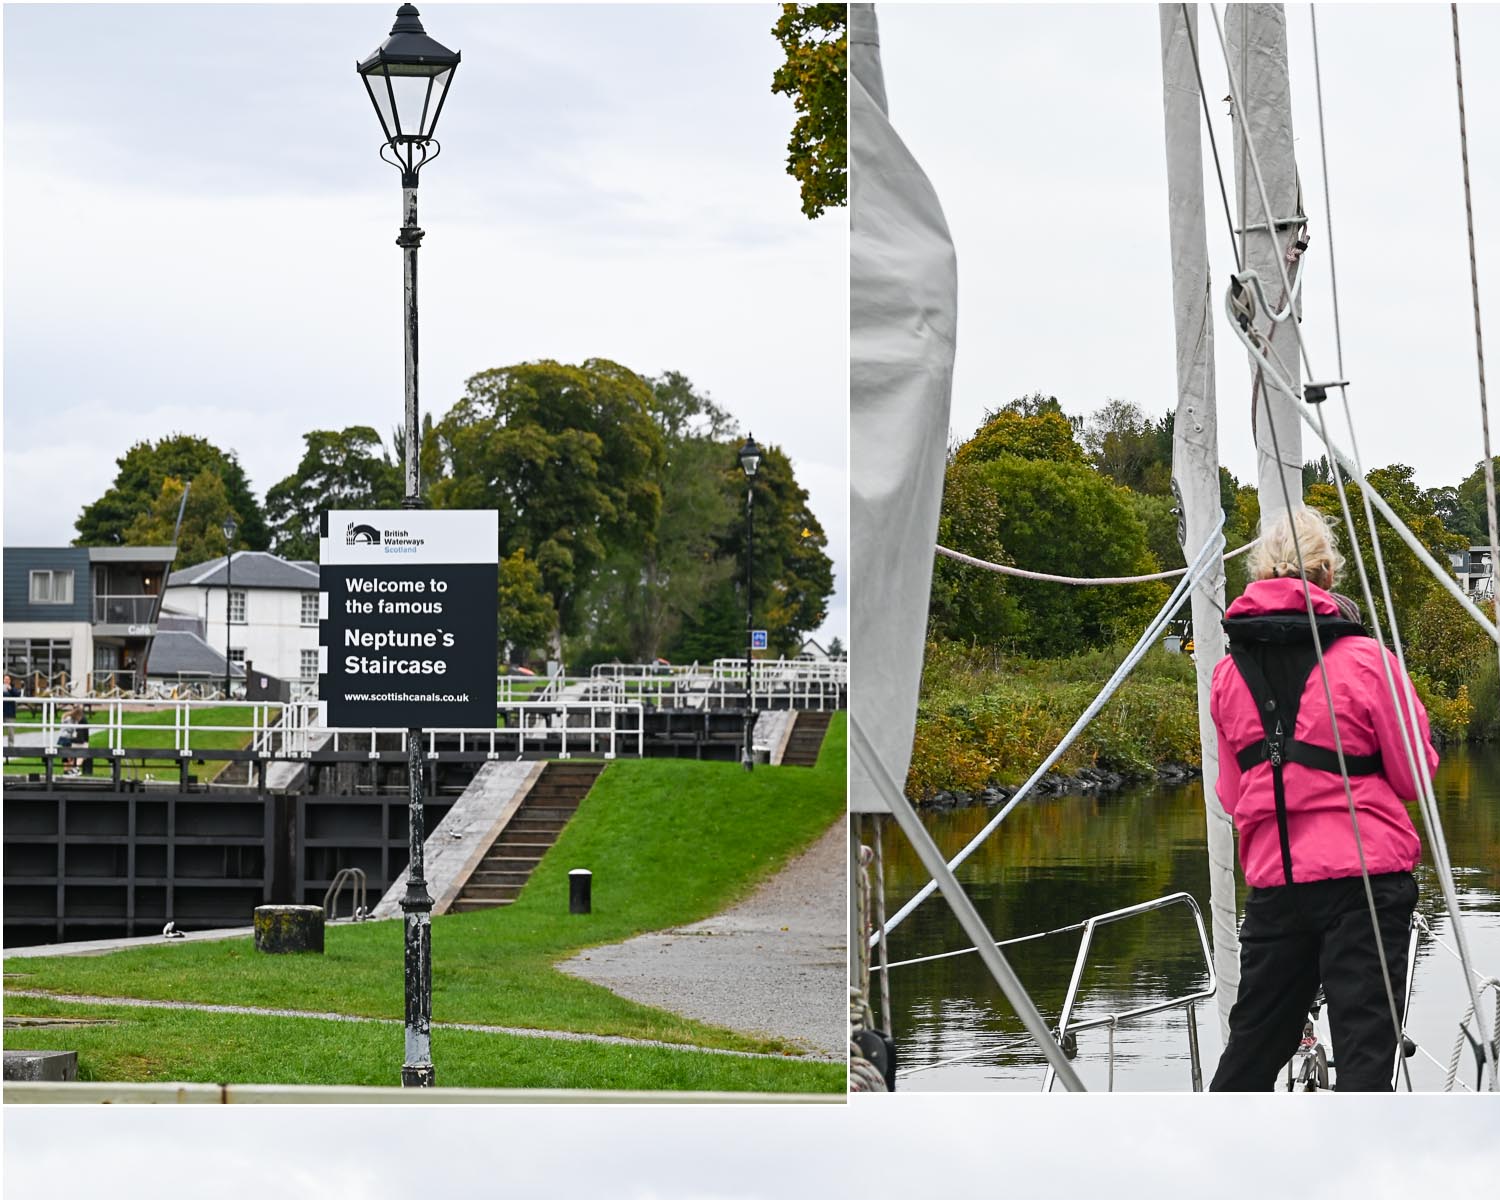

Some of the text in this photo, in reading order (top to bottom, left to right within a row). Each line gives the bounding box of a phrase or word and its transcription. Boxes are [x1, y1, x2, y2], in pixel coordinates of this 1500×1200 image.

[384, 530, 409, 538] British
[384, 538, 425, 546] Waterways
[384, 546, 417, 554] Scotland
[345, 578, 448, 593] Welcome to
[345, 599, 443, 614] the famous
[344, 655, 447, 675] Staircase
[344, 692, 469, 702] www.scottishcanals.co.uk
